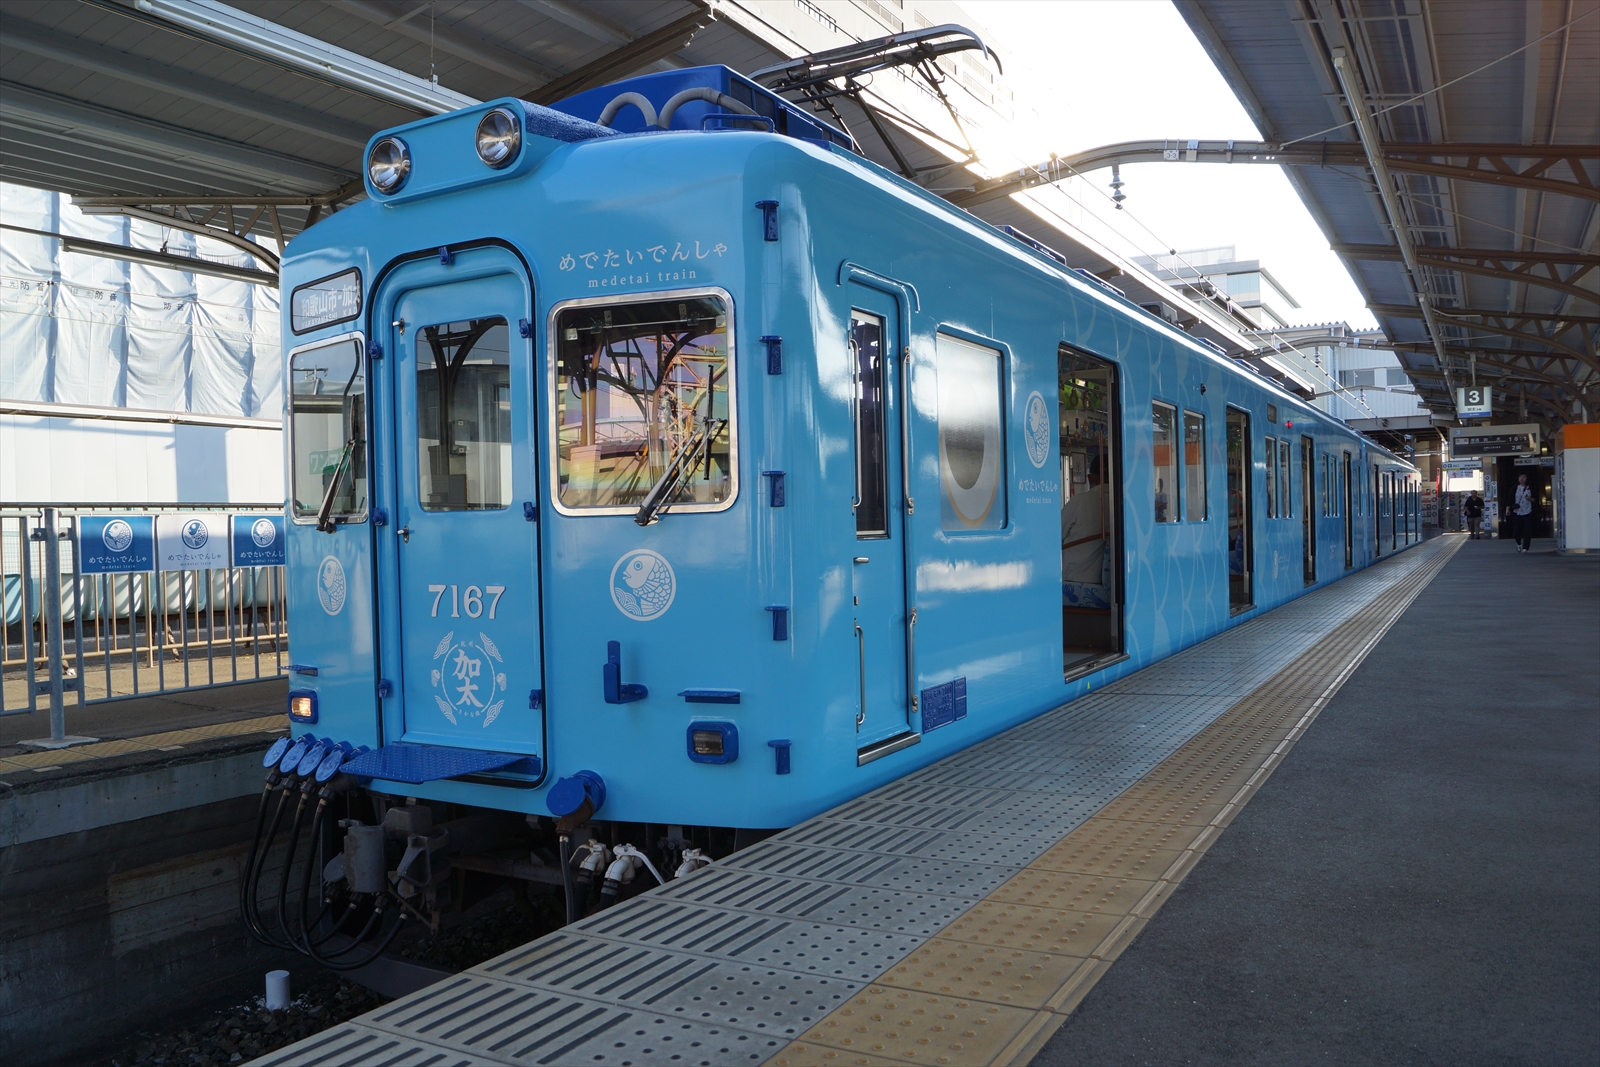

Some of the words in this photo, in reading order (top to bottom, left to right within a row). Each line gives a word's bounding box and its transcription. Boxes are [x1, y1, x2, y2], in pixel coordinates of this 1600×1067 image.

[559, 240, 728, 272] めでたいでんしゃ
[588, 272, 650, 288] medetai
[657, 268, 697, 282] train
[1468, 390, 1480, 403] 3
[1018, 479, 1058, 492] めでたいでんしゃ
[88, 555, 147, 565] めでたいでんしゃ
[167, 552, 222, 561] めでたいでんしゃ
[240, 550, 284, 559] めでたいでんし
[428, 584, 507, 620] 7167
[451, 648, 485, 708] 加太
